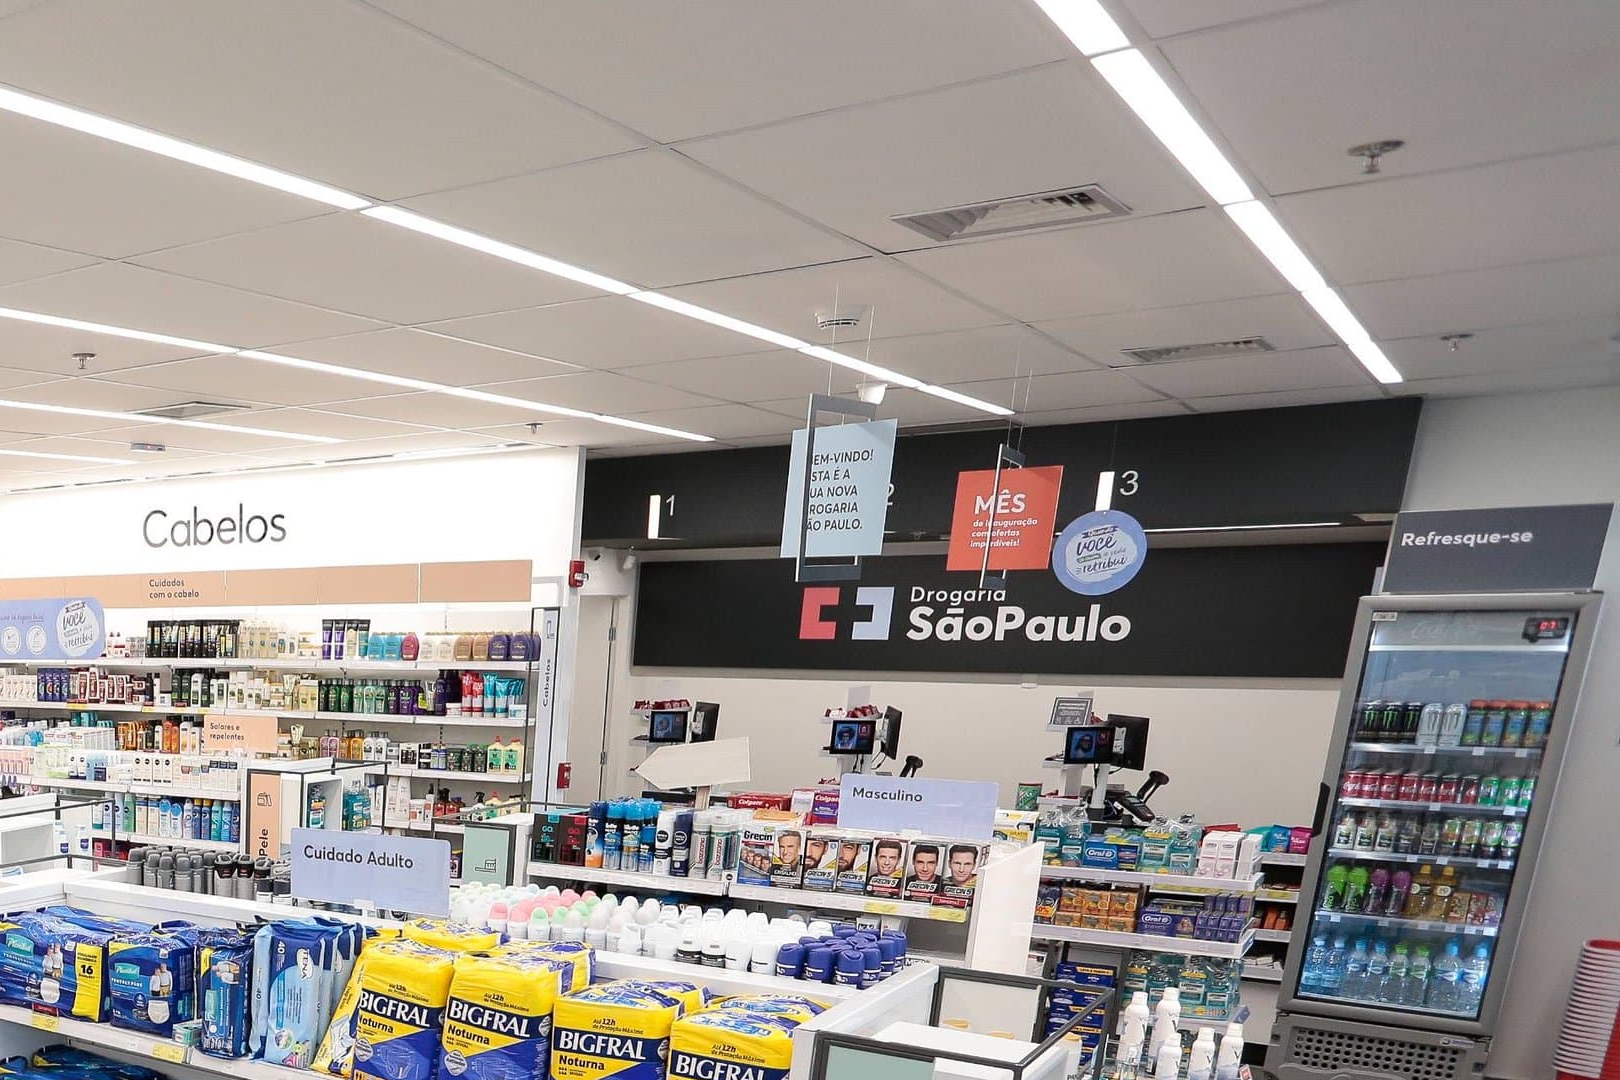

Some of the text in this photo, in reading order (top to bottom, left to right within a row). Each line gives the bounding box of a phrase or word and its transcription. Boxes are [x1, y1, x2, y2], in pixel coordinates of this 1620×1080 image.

[811, 449, 874, 466] EM-VINDO!
[811, 466, 851, 482] STA É A
[1119, 470, 1140, 496] 3
[809, 485, 858, 499] UA NOVA
[665, 494, 677, 517] 1
[808, 502, 858, 516] ROGARIA
[974, 490, 1026, 515] MÊS
[142, 503, 287, 548] Cabelos
[824, 519, 863, 532] PAULO.
[973, 519, 983, 528] de
[1401, 527, 1534, 549] Refresque-se
[149, 577, 185, 589] Cuidados
[175, 588, 199, 598] cabelo
[909, 585, 1006, 608] Drogaria
[905, 603, 1131, 642] SãoPaulo
[540, 656, 551, 709] Cabelos
[210, 722, 234, 731] Solares
[209, 731, 244, 742] repelentes
[853, 787, 923, 803] Masculino
[259, 828, 270, 857] Pele
[743, 831, 773, 842] Grecin
[303, 841, 414, 869] Cuidado Adulto
[80, 964, 94, 975] 16
[449, 999, 531, 1038] BIGFRAL
[602, 1018, 616, 1027] 12h
[448, 1024, 490, 1046] Noturna
[559, 1031, 646, 1061] BIGFRAL
[721, 1044, 736, 1053] 12h
[558, 1054, 605, 1071] Noturna
